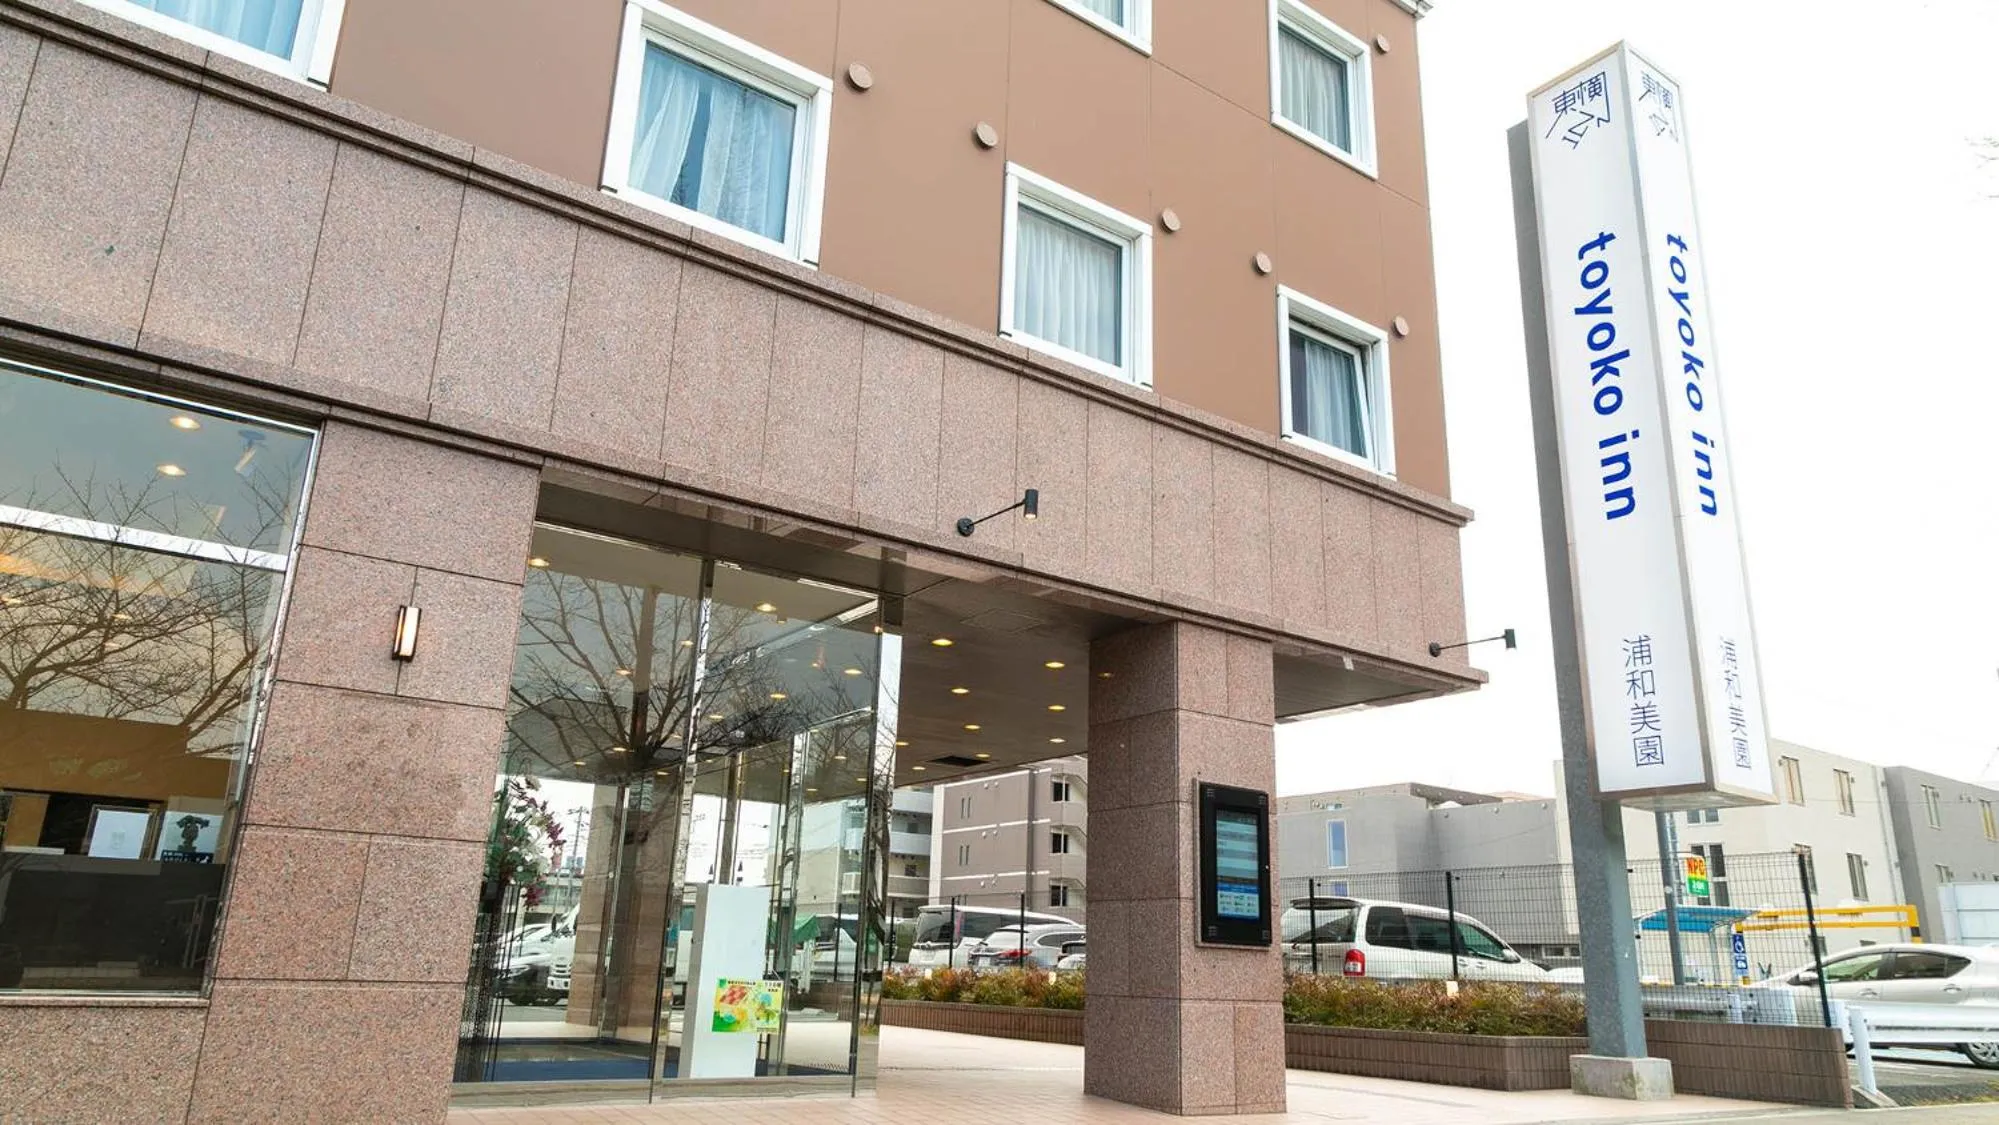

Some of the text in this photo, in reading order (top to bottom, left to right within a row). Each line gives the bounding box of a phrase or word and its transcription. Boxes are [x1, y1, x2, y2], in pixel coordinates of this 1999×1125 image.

[1574, 231, 1640, 520] toyoko inn
[1667, 233, 1718, 517] toyoko inn
[1622, 634, 1664, 767] 浦和美園
